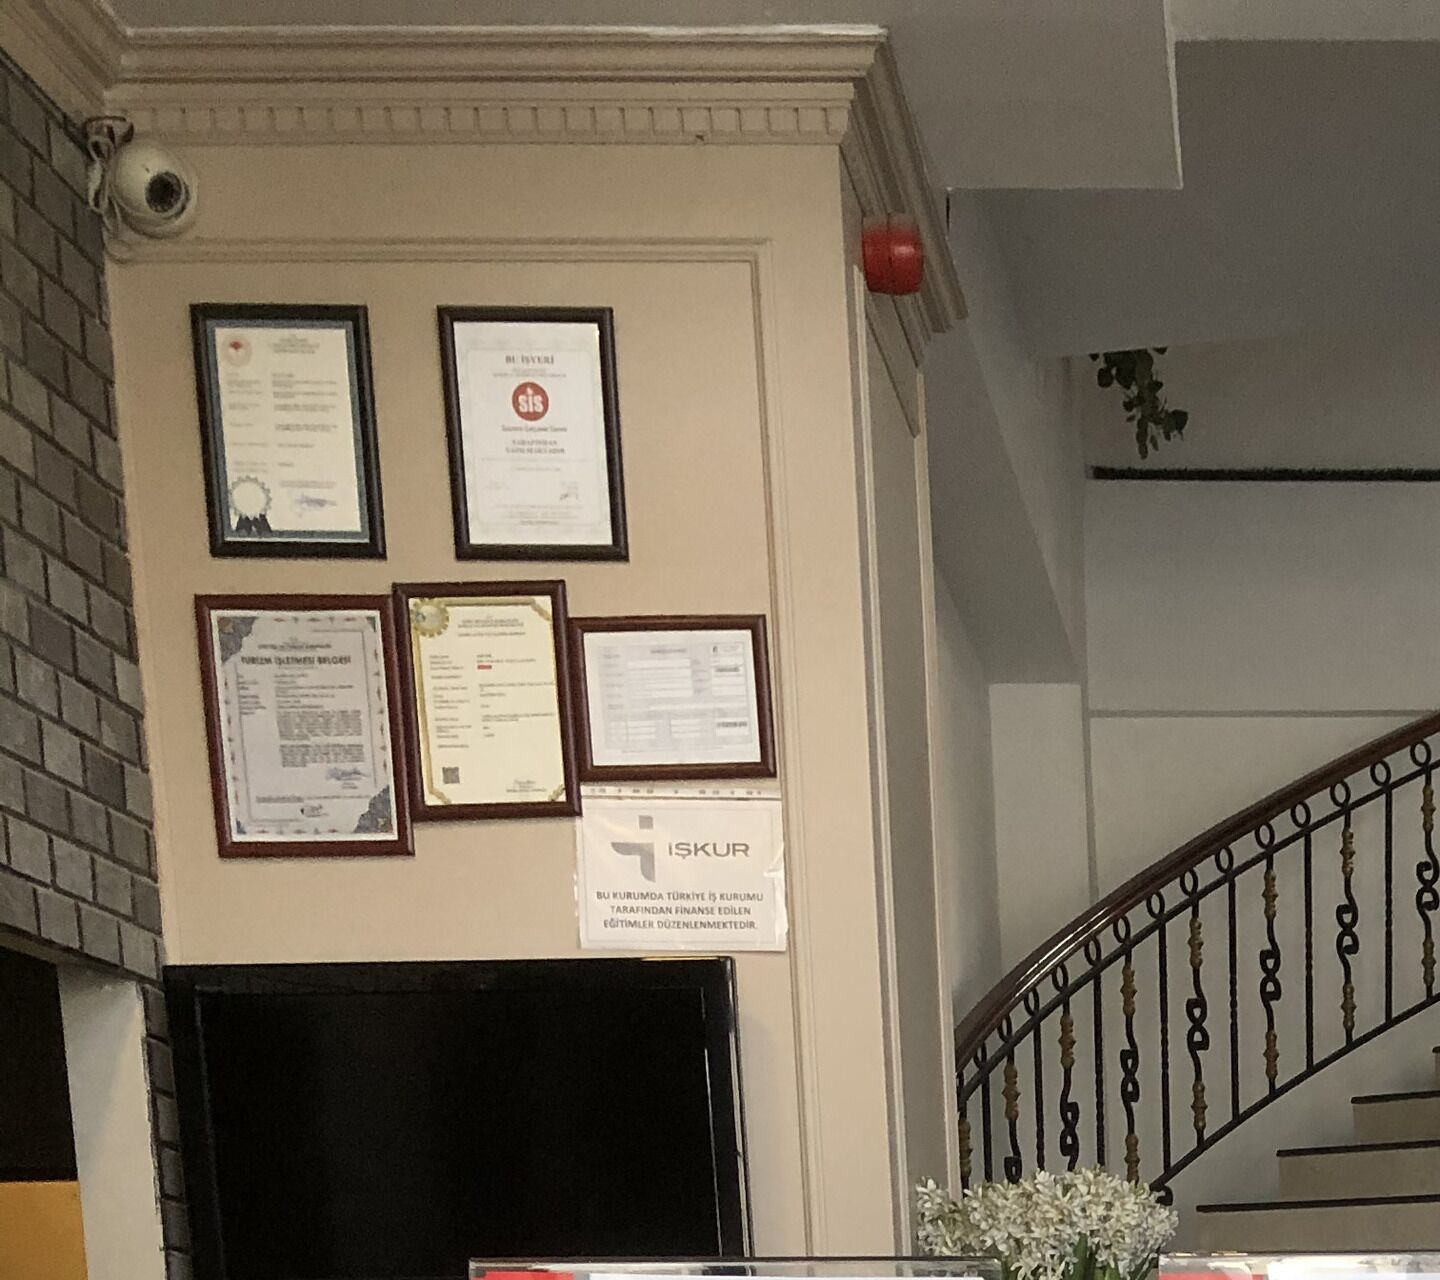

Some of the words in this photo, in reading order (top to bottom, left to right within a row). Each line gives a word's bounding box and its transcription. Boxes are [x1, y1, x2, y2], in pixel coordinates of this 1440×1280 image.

[668, 842, 750, 860] İŞKUR
[596, 890, 610, 901] BU
[612, 890, 664, 901] KURUMDA
[666, 890, 706, 901] TÜRKİYE
[709, 890, 717, 903] İŞ
[719, 891, 763, 902] KURUMU
[610, 904, 673, 915] TARAFINDAN
[675, 904, 715, 915] FİNANSE
[717, 904, 751, 916] EDİLEN
[603, 917, 655, 929] EĞİTİMLER
[657, 917, 758, 930] DÜZENLENMEKTEDİR.
